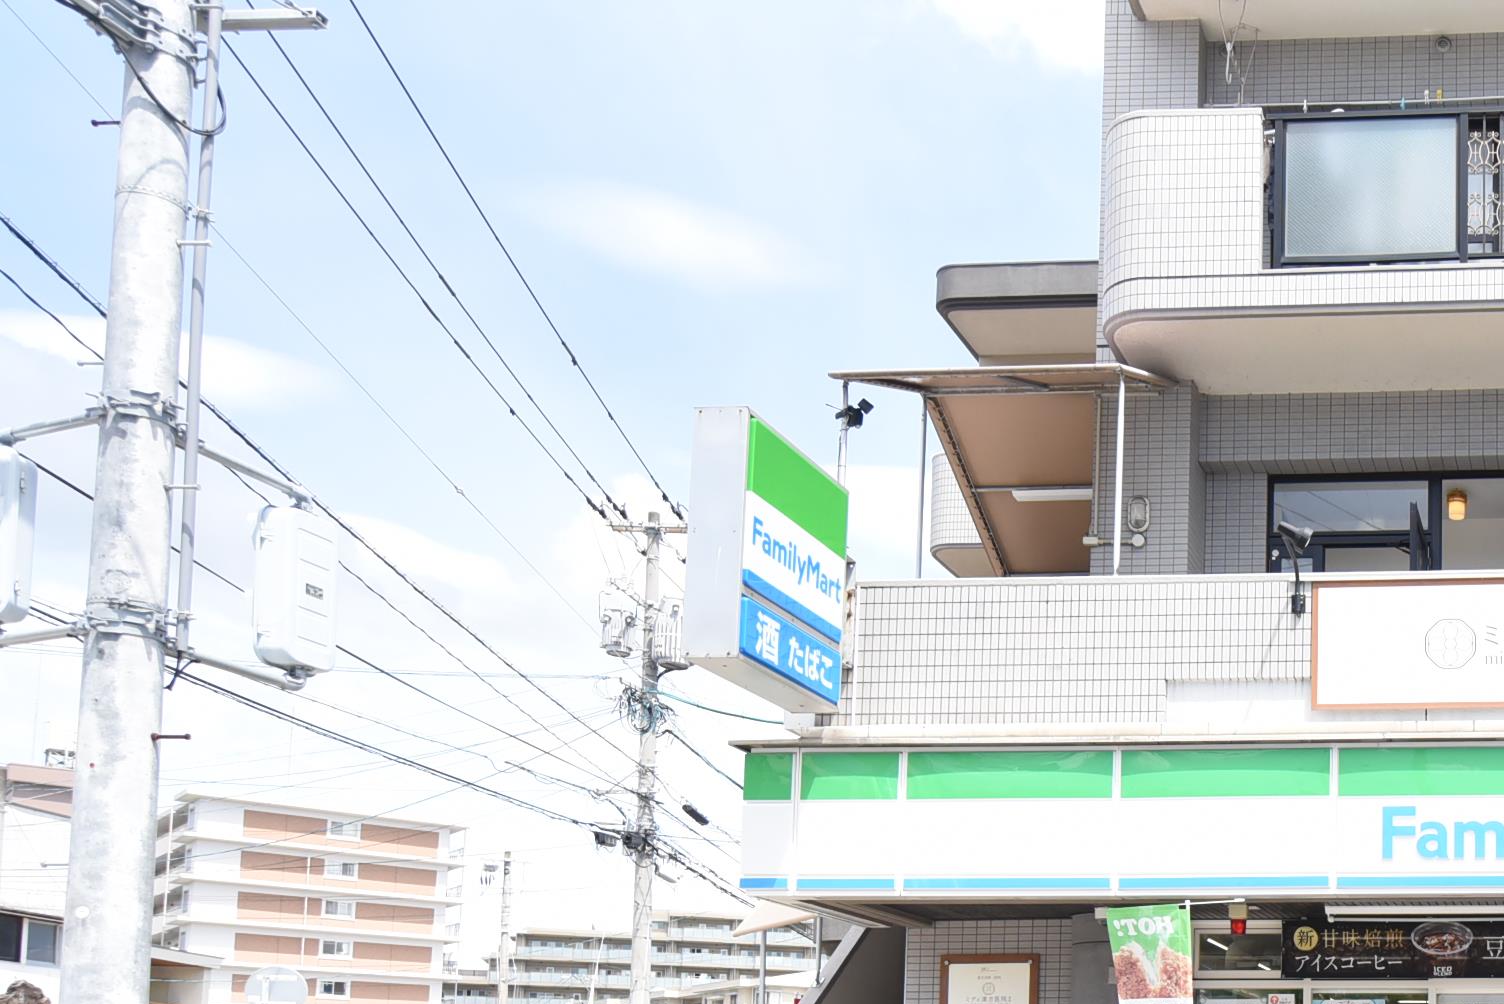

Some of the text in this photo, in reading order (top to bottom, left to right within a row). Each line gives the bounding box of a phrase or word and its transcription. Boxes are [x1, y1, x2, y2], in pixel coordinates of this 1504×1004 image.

[752, 515, 842, 604] FamilyMart
[755, 610, 833, 690] 酒 たばこ
[1295, 954, 1403, 973] アイスコーヒー
